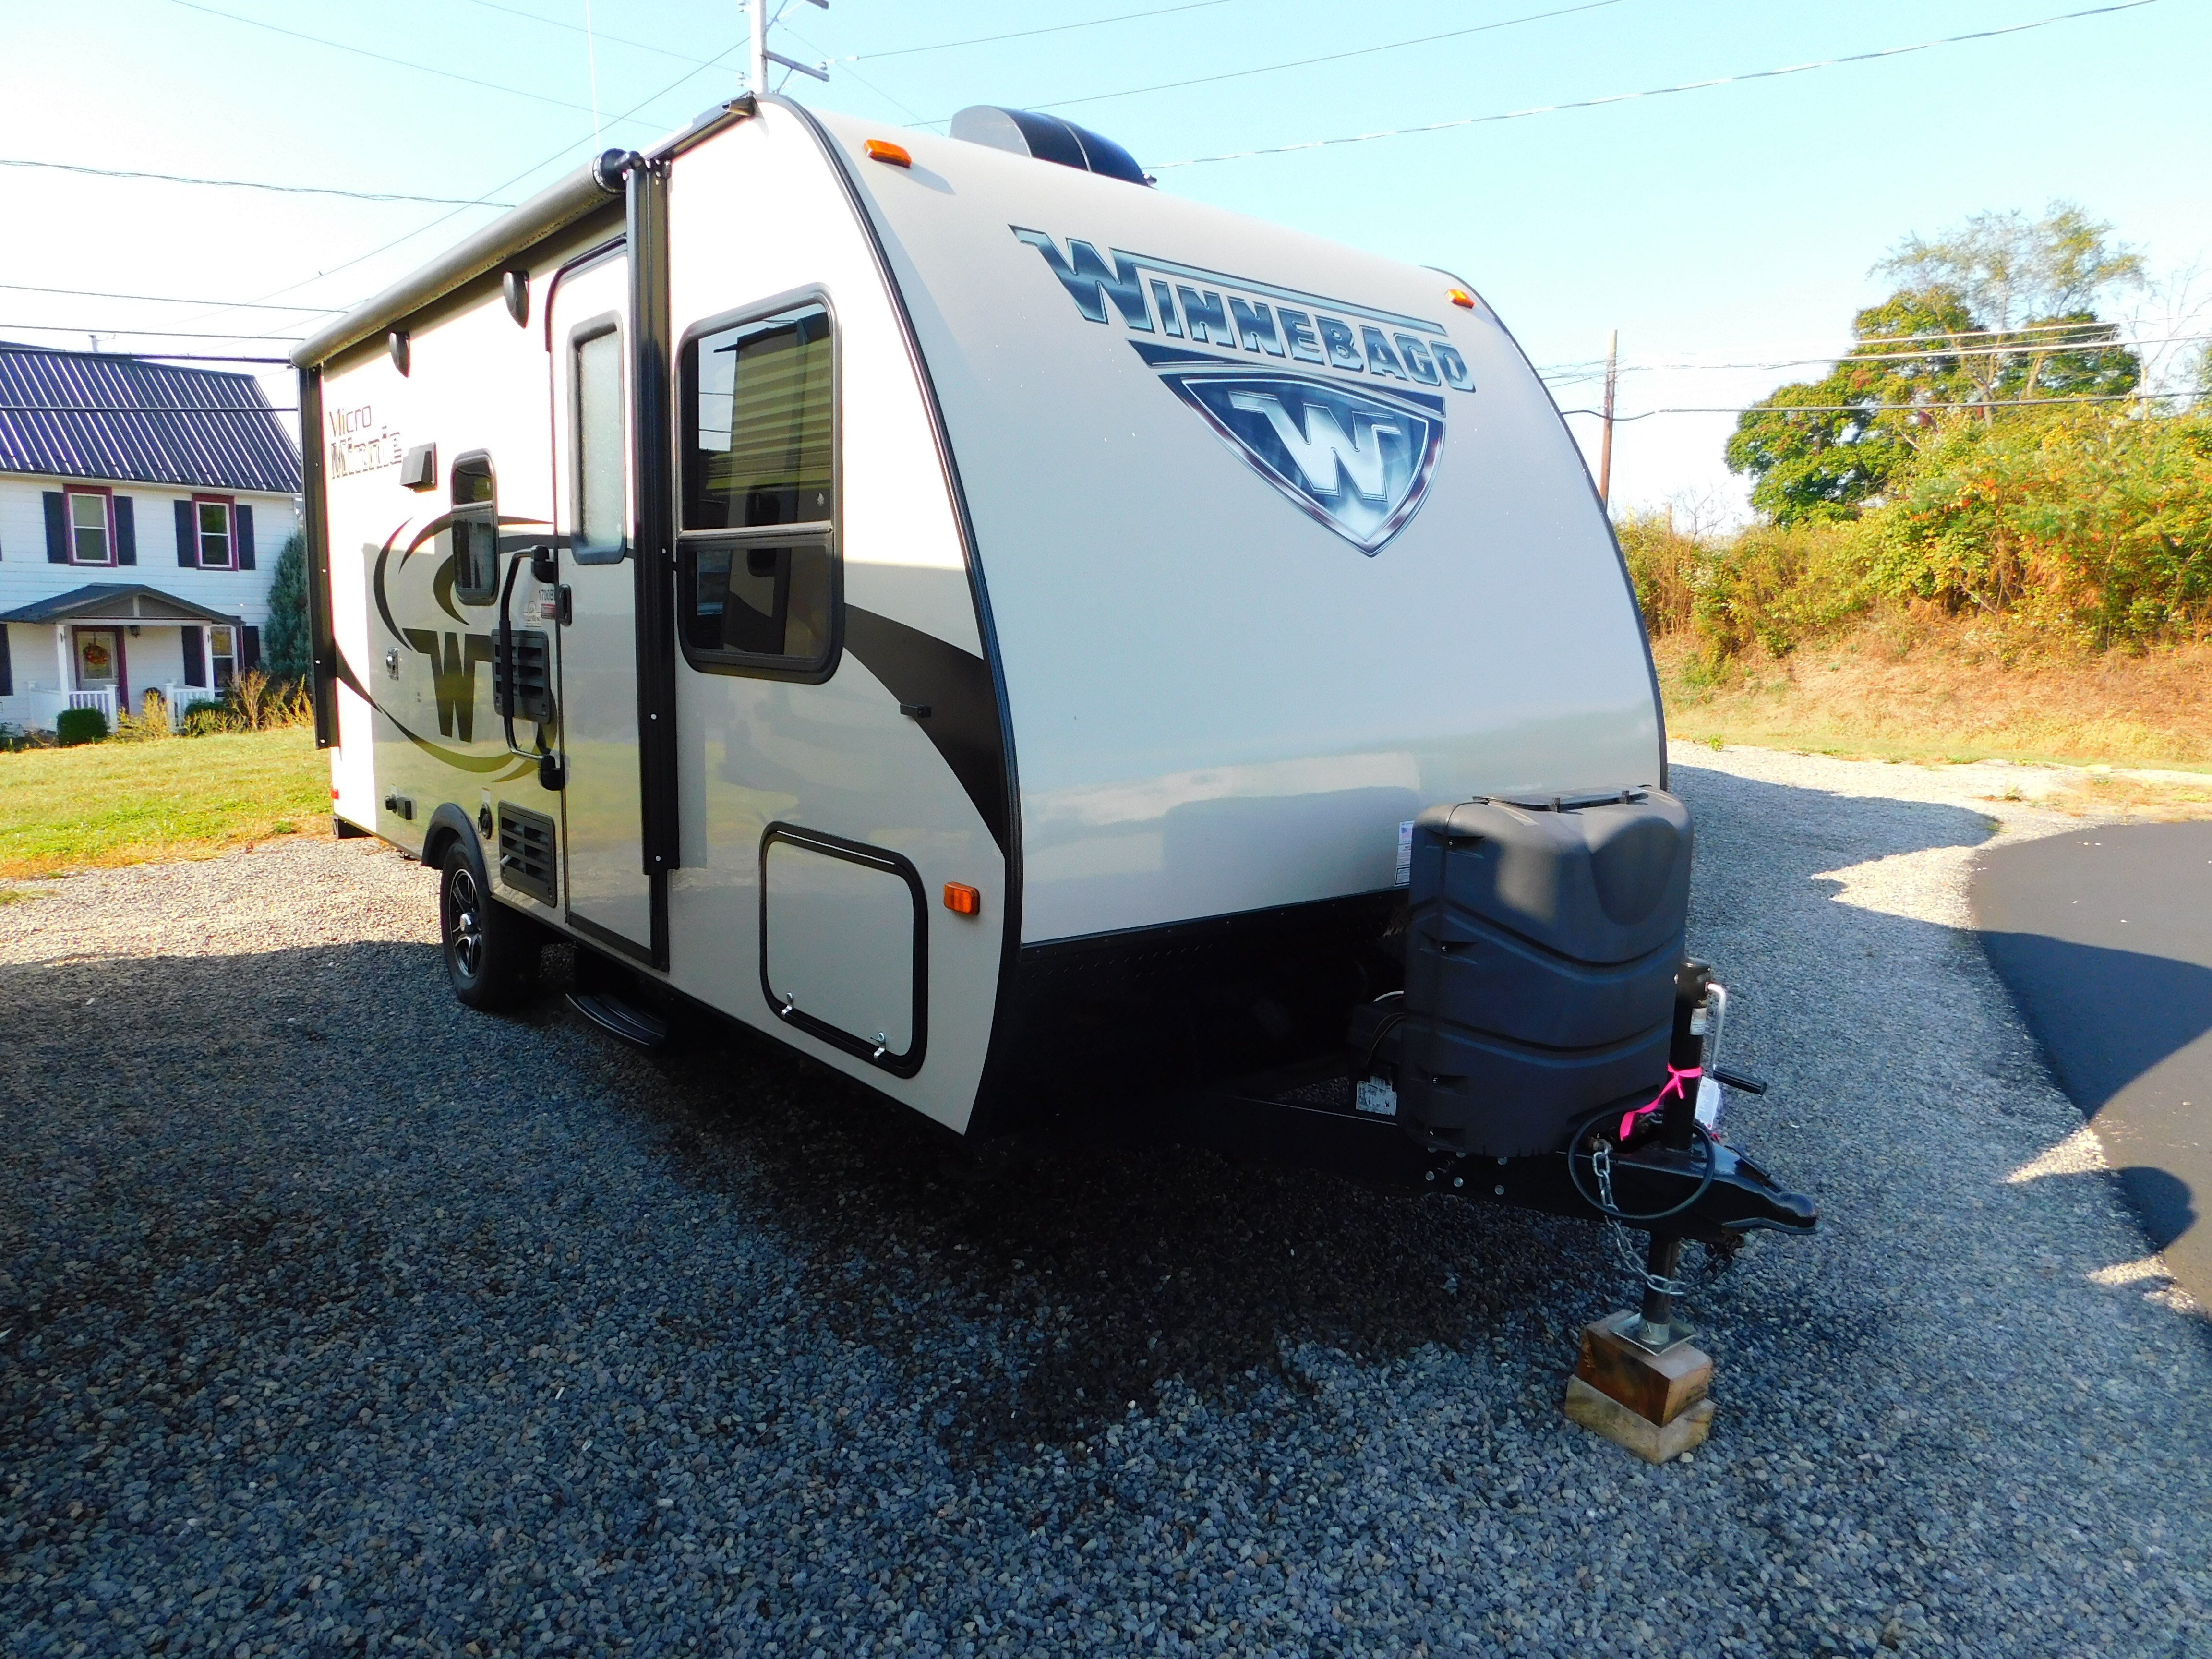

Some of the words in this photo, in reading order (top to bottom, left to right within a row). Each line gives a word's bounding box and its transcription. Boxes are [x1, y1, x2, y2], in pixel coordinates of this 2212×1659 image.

[1008, 224, 1475, 393] WINNEBAGO
[329, 405, 371, 437] Micro
[331, 426, 402, 479] Minnie
[1228, 391, 1402, 501] W
